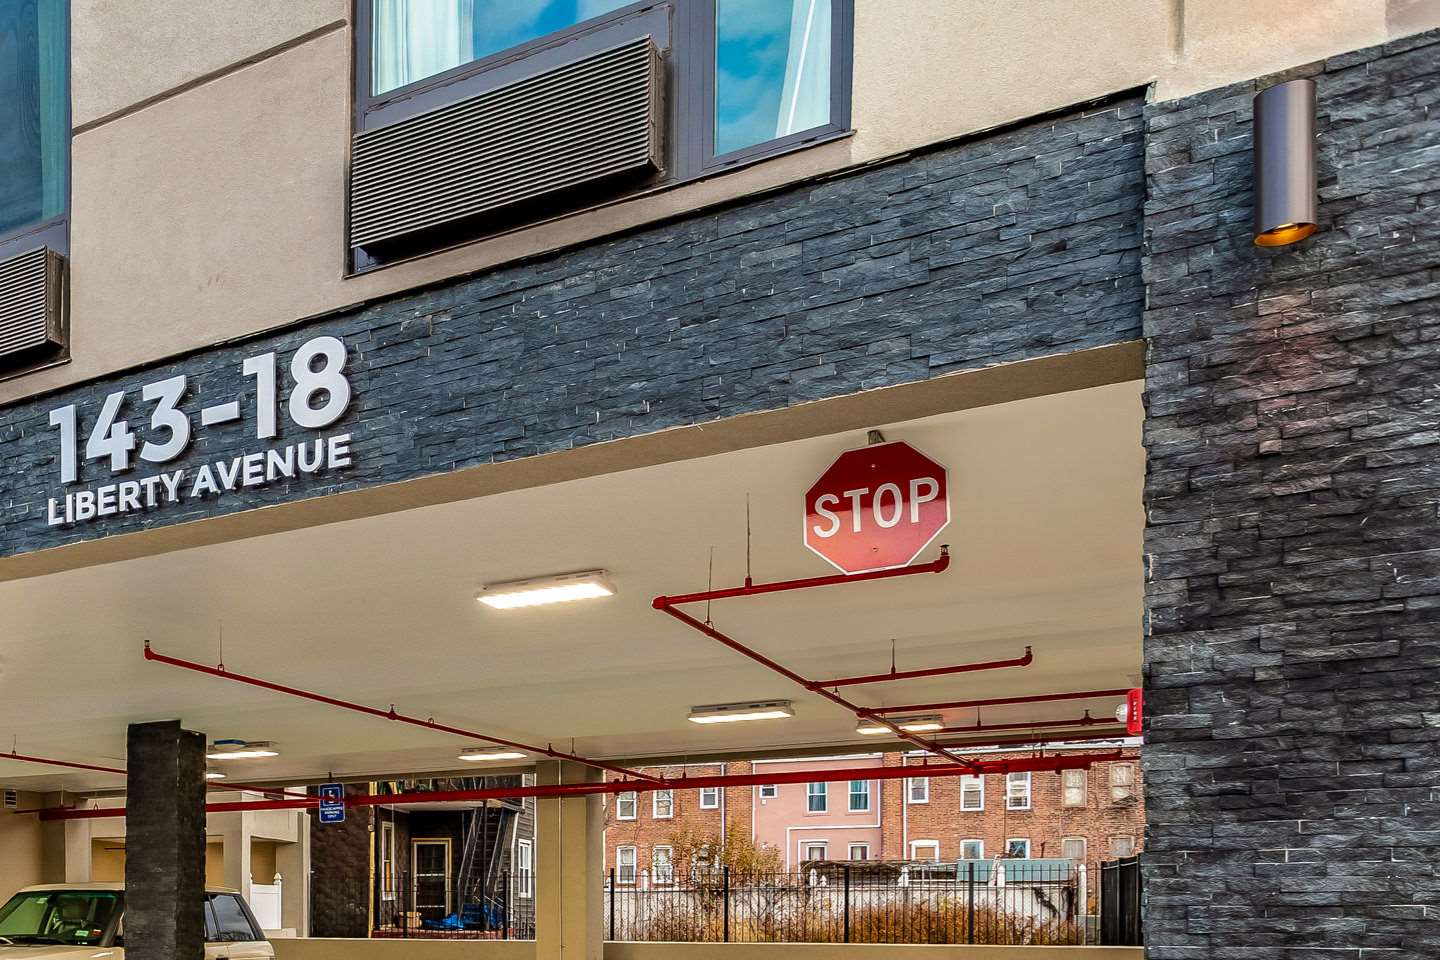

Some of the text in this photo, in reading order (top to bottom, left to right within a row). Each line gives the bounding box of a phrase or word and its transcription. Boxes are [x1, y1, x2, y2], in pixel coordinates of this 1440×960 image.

[48, 335, 351, 483] 143-18
[47, 432, 354, 527] LIBERTY AVENUE
[812, 476, 940, 539] STOP
